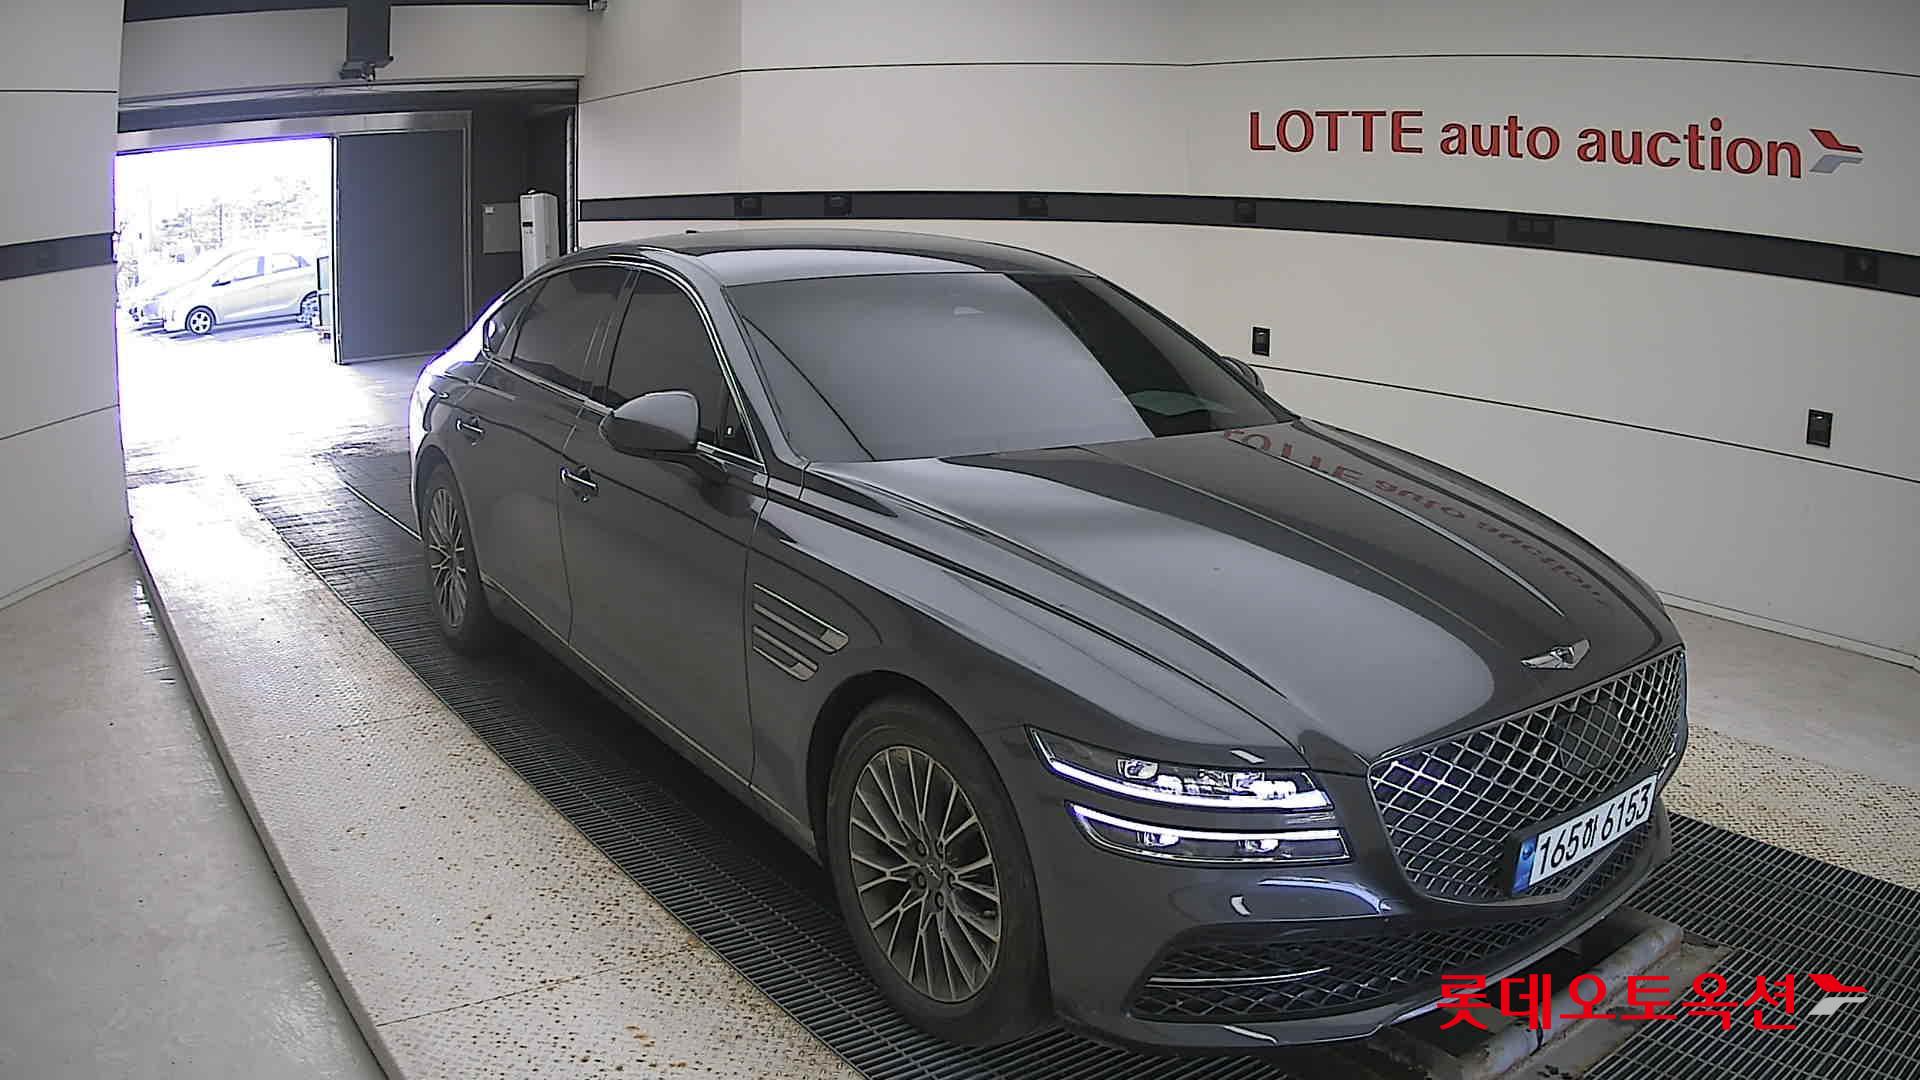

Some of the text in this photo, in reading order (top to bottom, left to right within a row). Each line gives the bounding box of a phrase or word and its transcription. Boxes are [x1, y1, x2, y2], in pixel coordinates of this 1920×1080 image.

[1250, 111, 1802, 178] LOTTE auto auction
[1601, 783, 1651, 840] 6153
